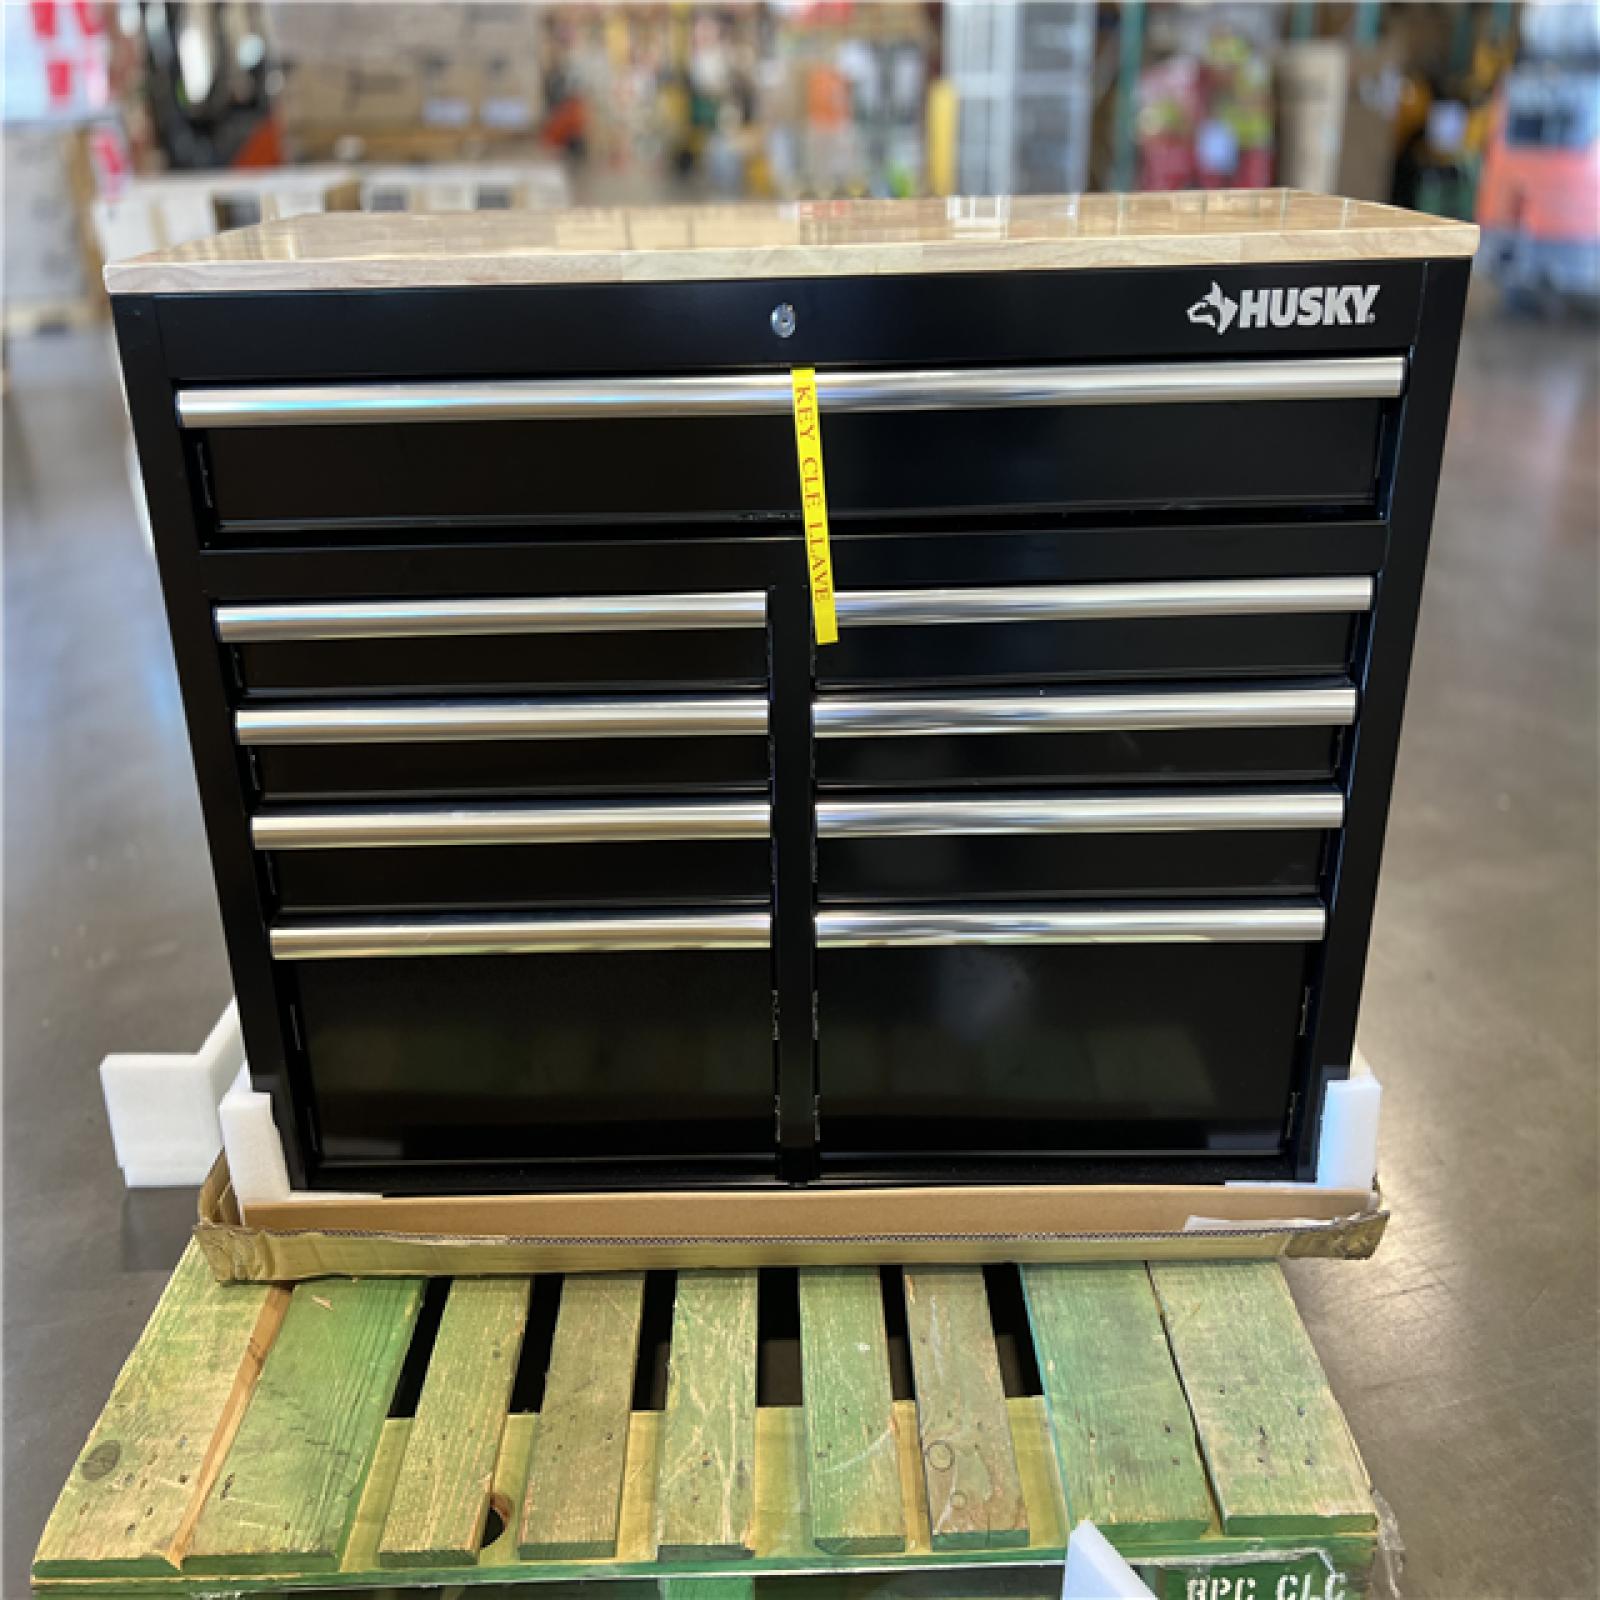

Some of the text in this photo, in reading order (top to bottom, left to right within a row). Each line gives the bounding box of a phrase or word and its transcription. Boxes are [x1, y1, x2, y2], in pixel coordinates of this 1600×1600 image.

[1239, 285, 1381, 328] HUSKY
[796, 386, 816, 441] KEY
[808, 521, 831, 603] LLAVE
